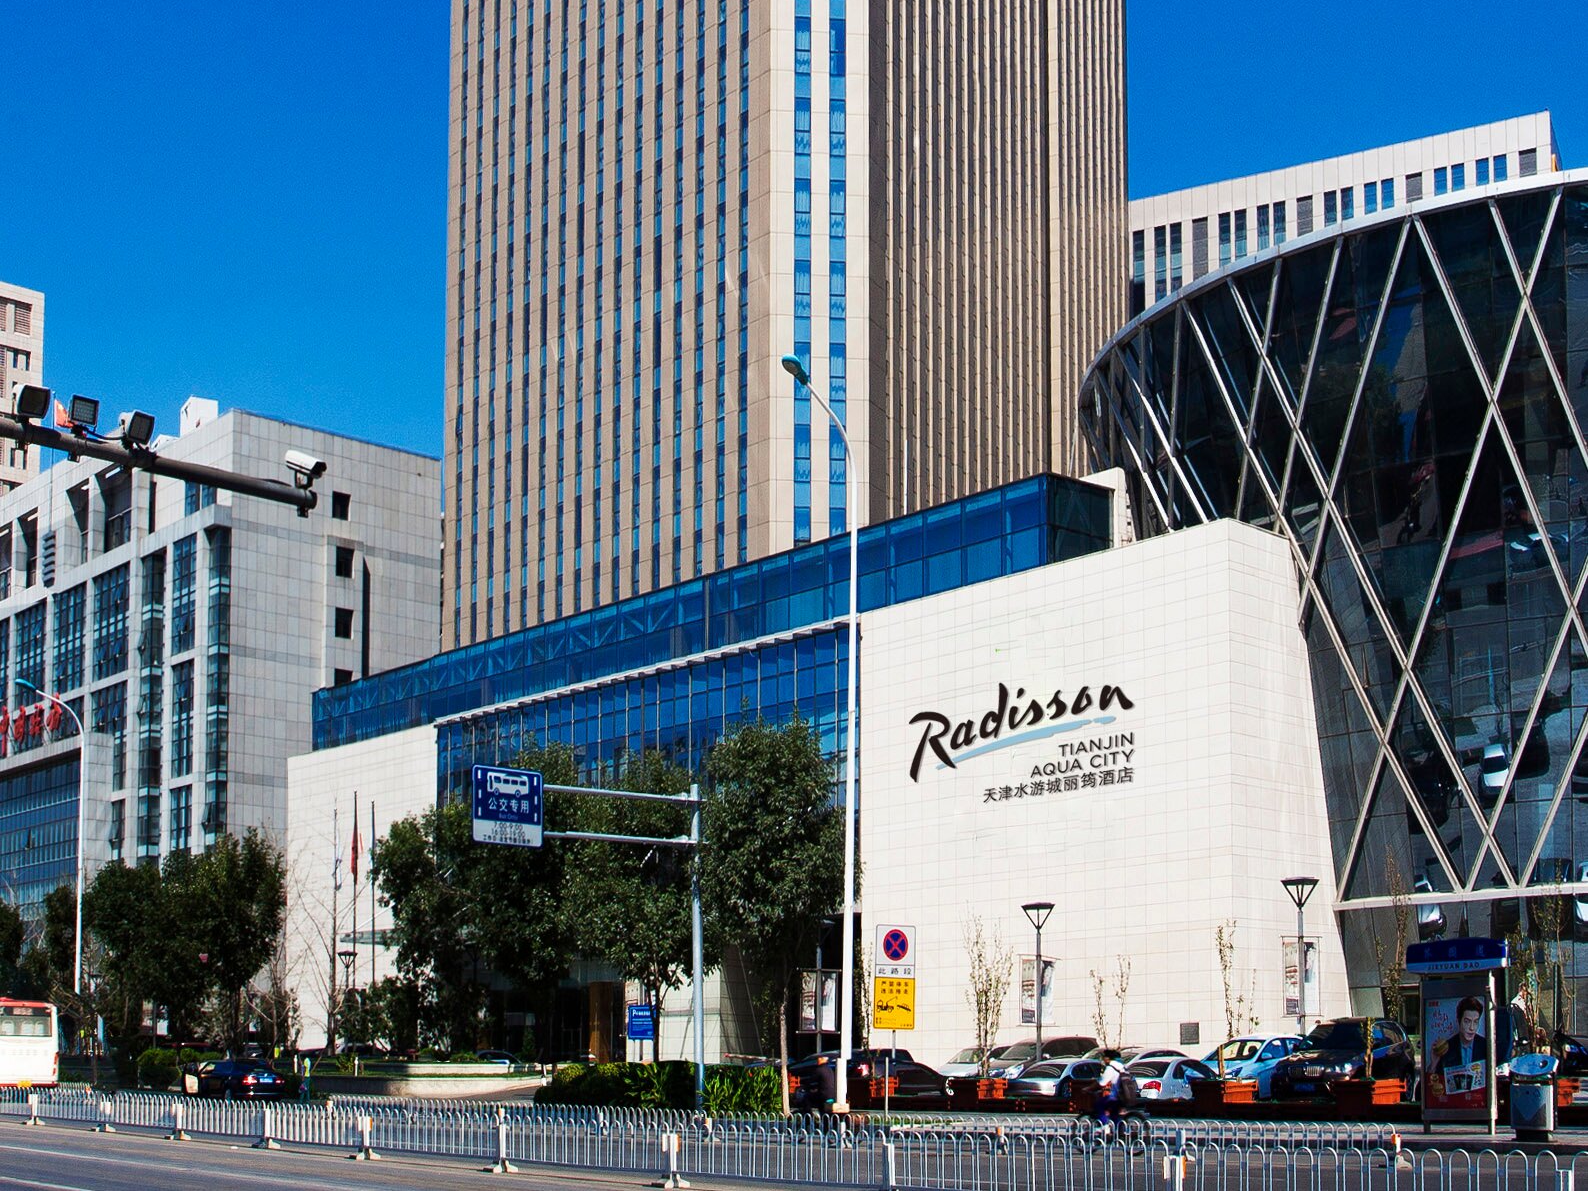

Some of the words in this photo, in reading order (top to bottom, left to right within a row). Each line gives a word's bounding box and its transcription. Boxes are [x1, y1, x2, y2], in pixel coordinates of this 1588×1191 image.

[909, 683, 1135, 783] Radisson
[1058, 732, 1135, 757] TIANJIN
[1030, 758, 1084, 778] AQUA
[1090, 749, 1135, 769] CITY
[983, 767, 1135, 803] 天津水游城丽筠酒店
[488, 796, 529, 814] 公交专用
[1463, 961, 1480, 969] DAO
